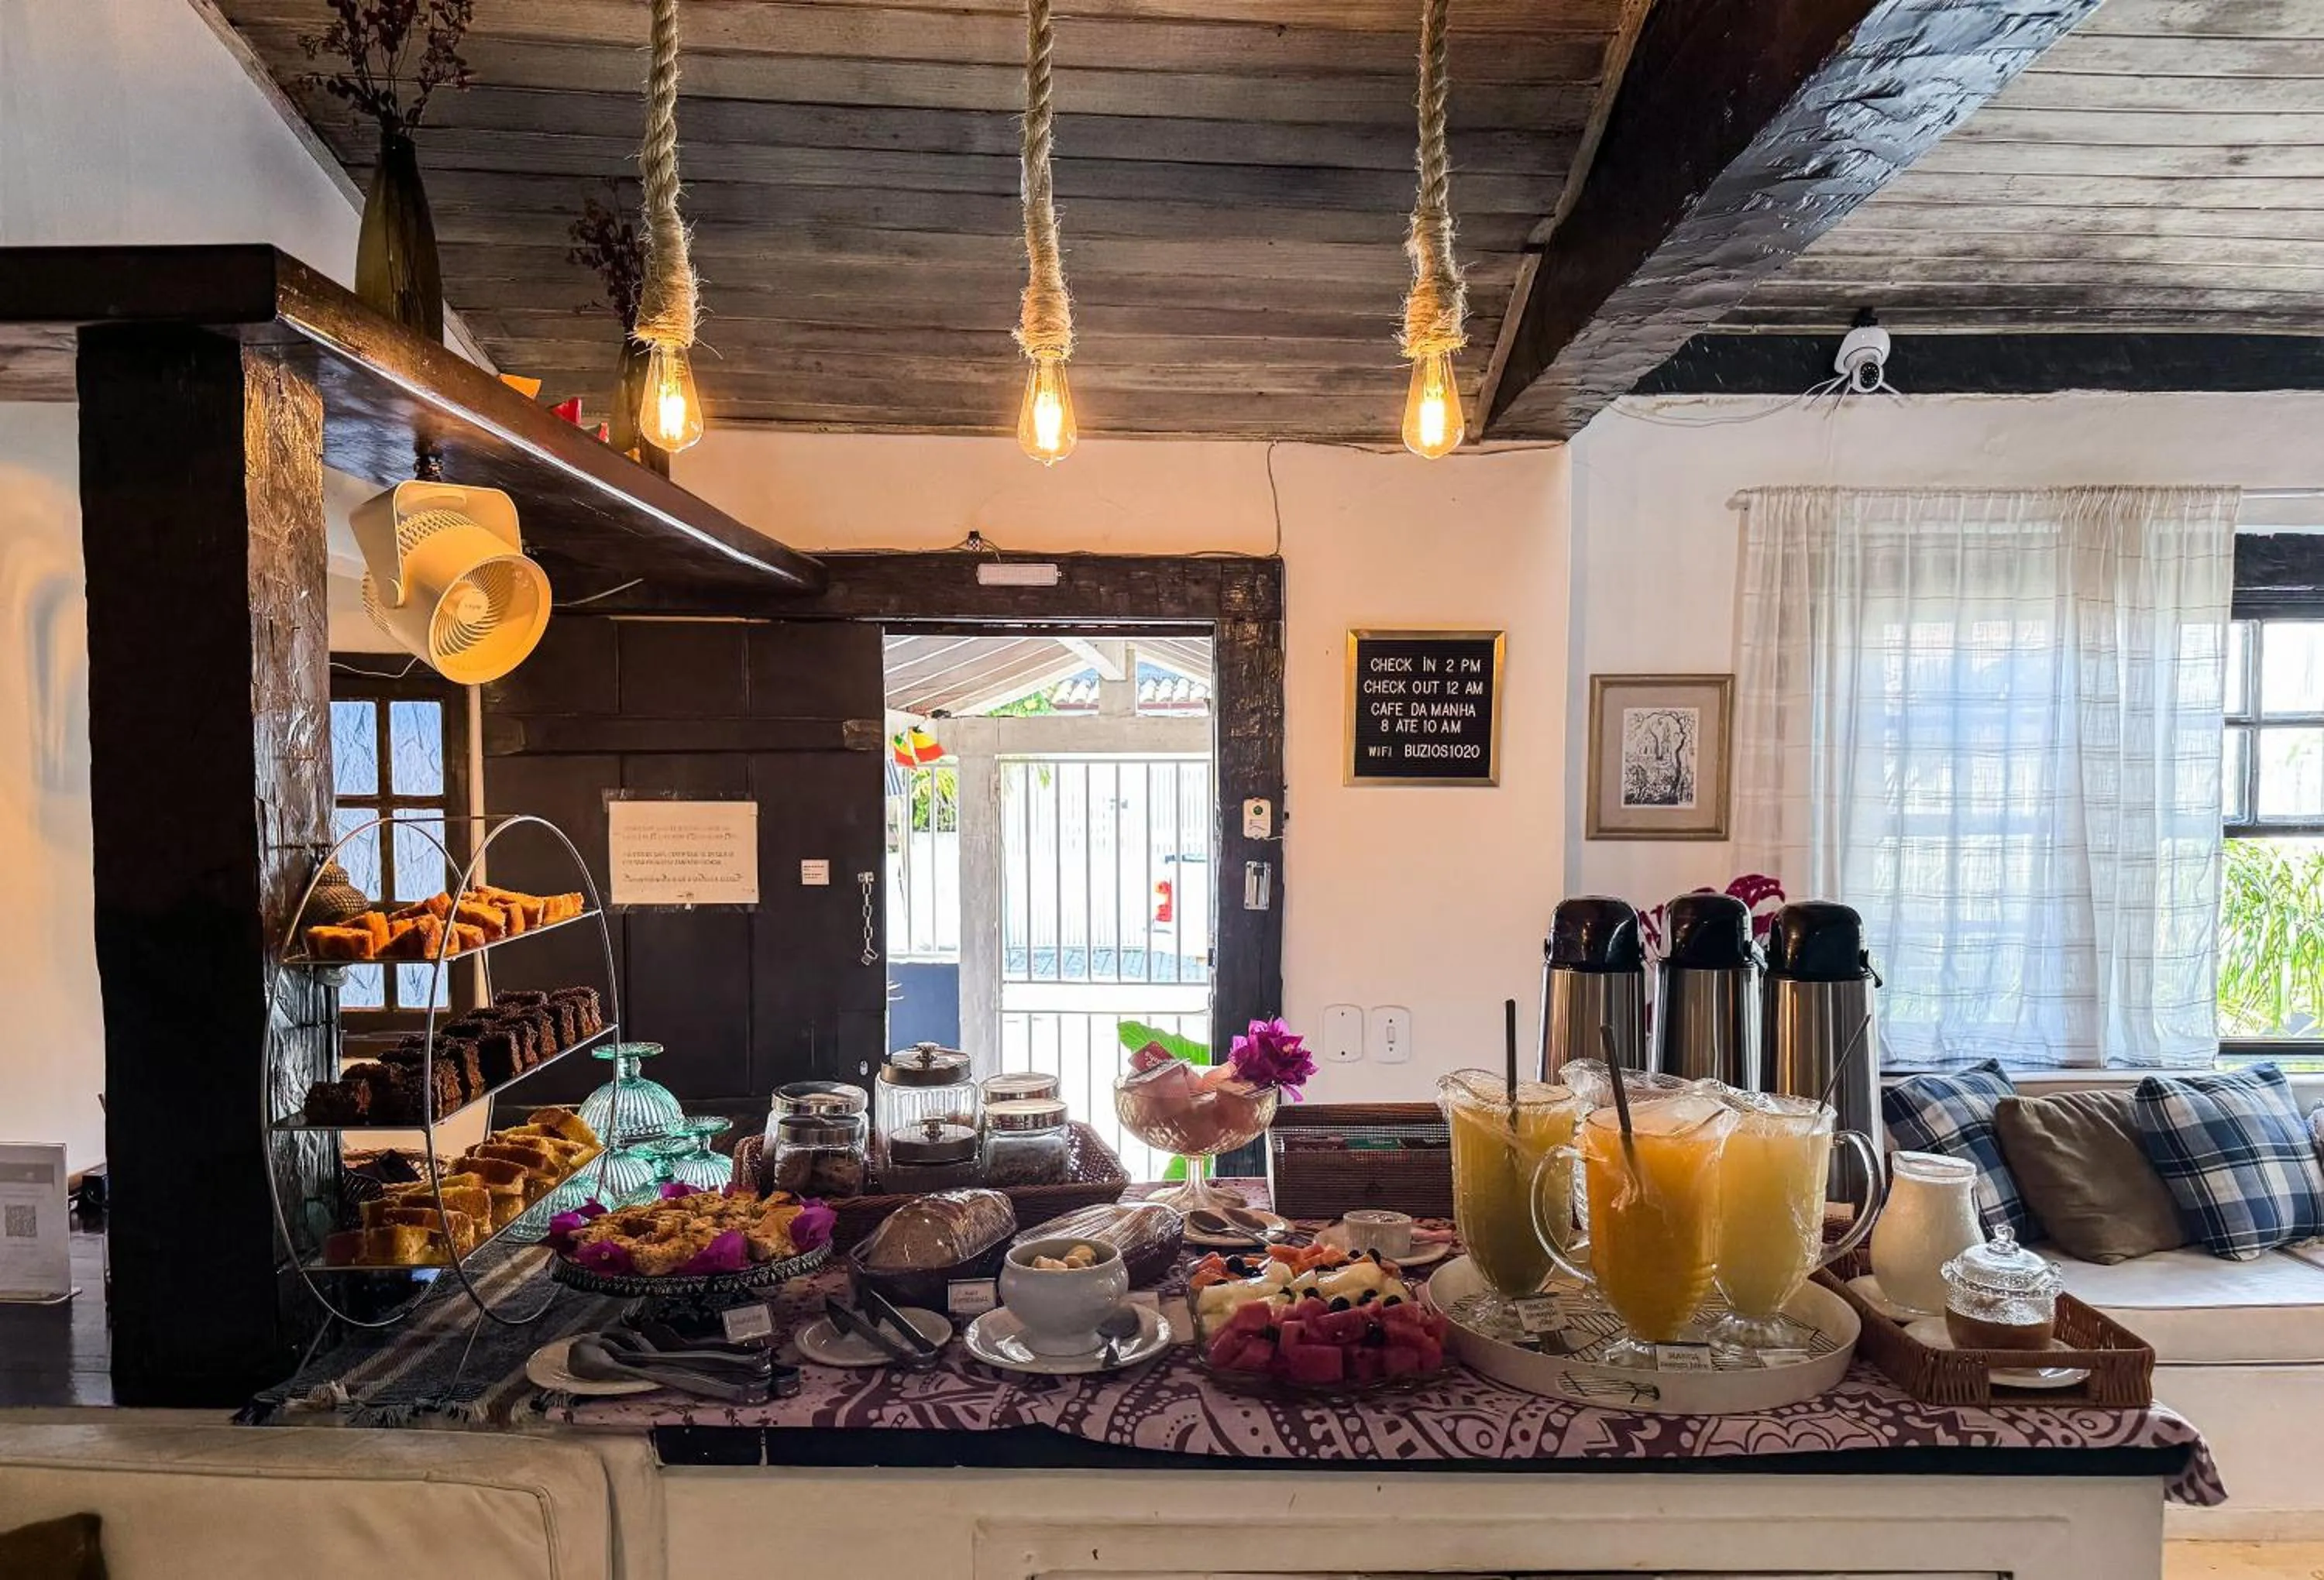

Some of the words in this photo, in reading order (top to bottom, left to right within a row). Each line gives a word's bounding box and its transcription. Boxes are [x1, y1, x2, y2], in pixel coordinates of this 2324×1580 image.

[1370, 658, 1412, 672] CHECK
[1423, 657, 1436, 672] IN
[1446, 659, 1453, 672] 2
[1461, 658, 1480, 673] PM
[1363, 679, 1406, 693] CHECK
[1412, 681, 1439, 694] OUT
[1447, 681, 1459, 695] 12
[1465, 681, 1483, 695] AM
[1370, 702, 1404, 716] CAFE
[1411, 702, 1428, 716] DA
[1431, 702, 1476, 717] MANHA
[1380, 719, 1389, 732] 8
[1395, 719, 1419, 733] ATE
[1423, 720, 1436, 733] 10
[1441, 720, 1462, 733] AM
[1368, 746, 1392, 757] WIFI
[1404, 744, 1480, 758] BUZIOS1020
